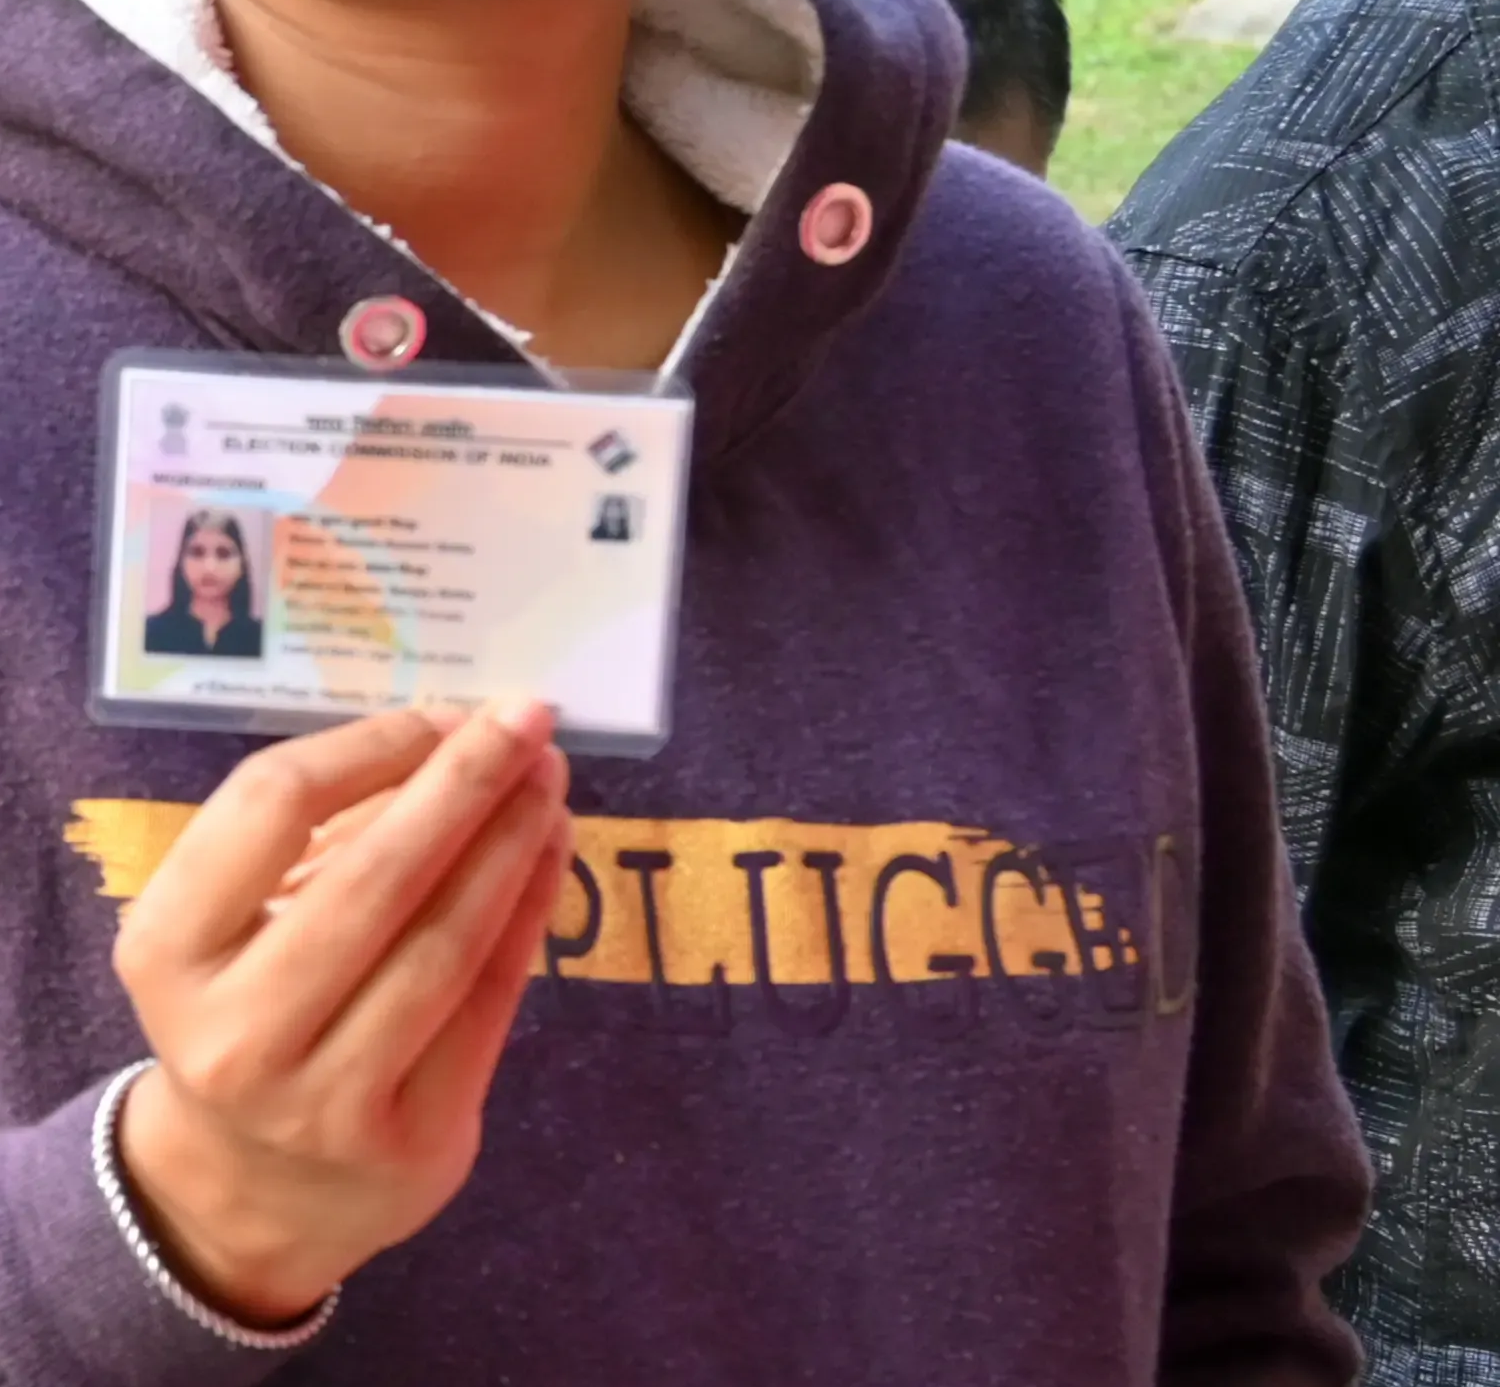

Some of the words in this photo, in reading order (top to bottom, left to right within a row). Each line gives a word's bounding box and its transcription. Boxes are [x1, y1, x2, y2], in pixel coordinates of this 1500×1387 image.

[222, 437, 322, 456] ELECTION
[331, 443, 459, 463] COMMISSION
[465, 450, 491, 465] OF
[496, 452, 554, 468] INDIA
